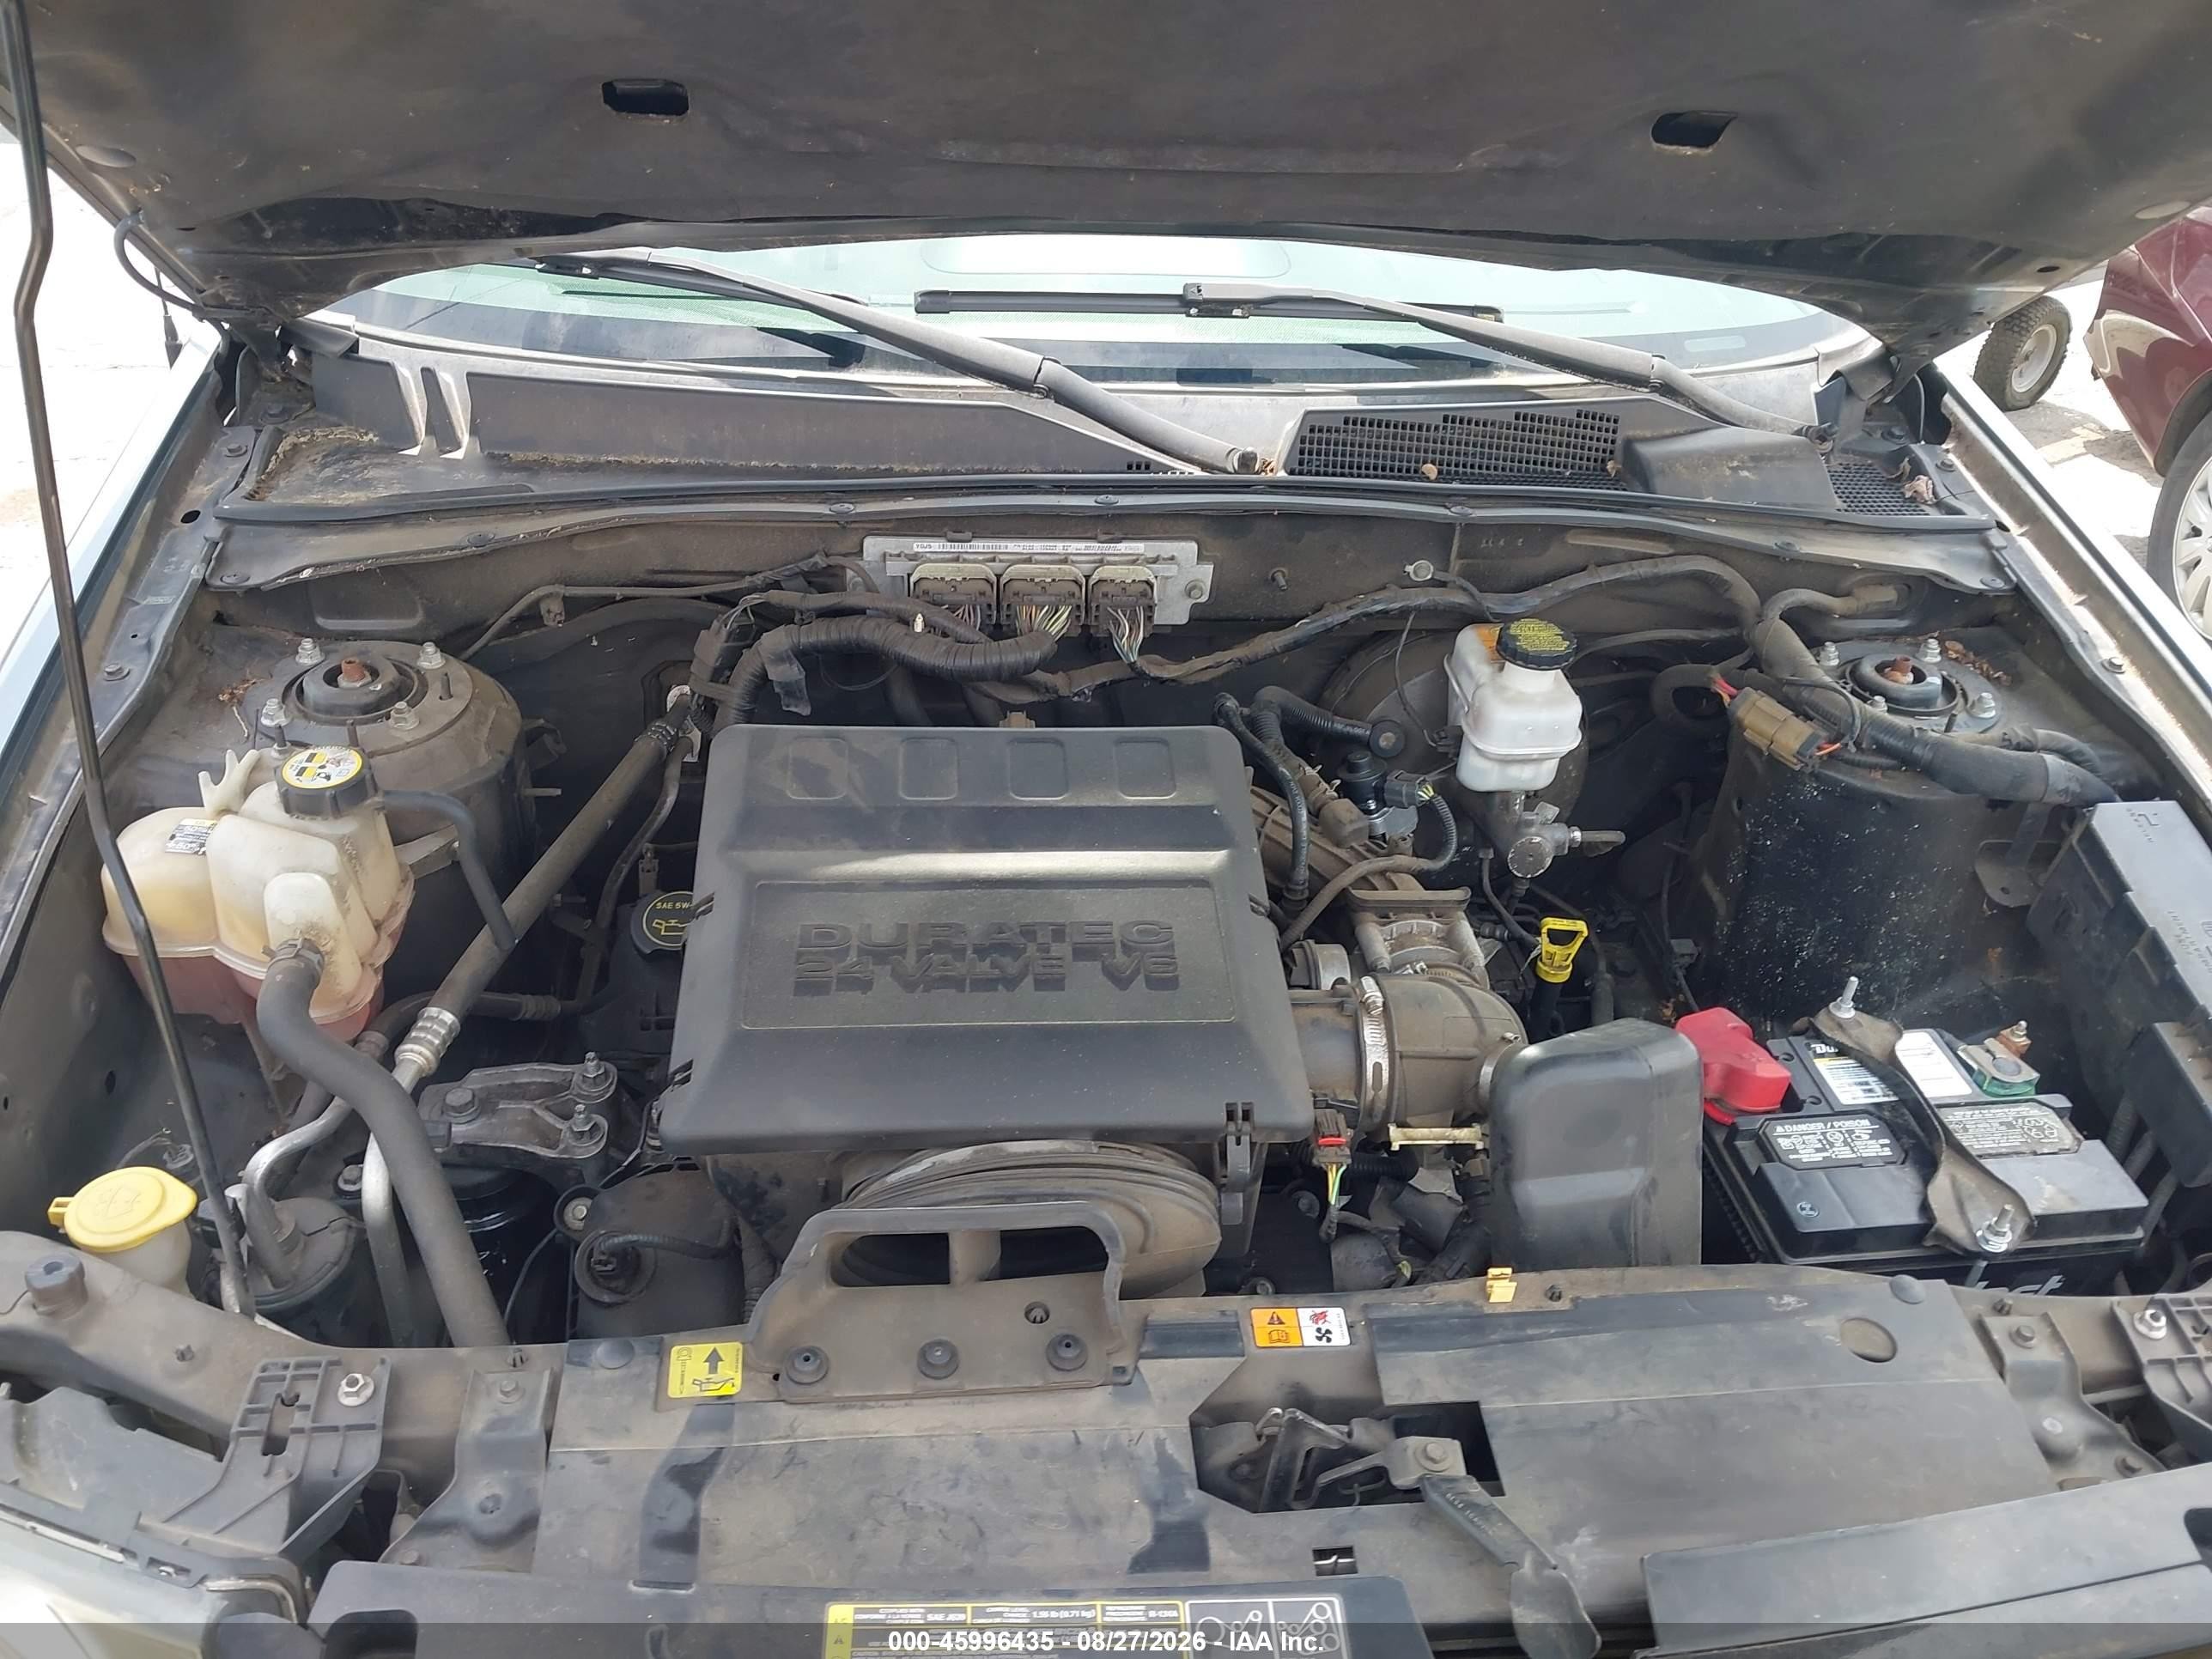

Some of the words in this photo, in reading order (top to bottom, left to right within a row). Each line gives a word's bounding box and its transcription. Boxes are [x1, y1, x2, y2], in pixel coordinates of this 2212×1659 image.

[795, 920, 1176, 957] DURATEC
[793, 954, 876, 995] 24
[890, 952, 1066, 994] VALVE
[1100, 952, 1180, 992] V6
[1784, 1121, 1826, 1132] DANGER
[1832, 1119, 1872, 1128] POISON
